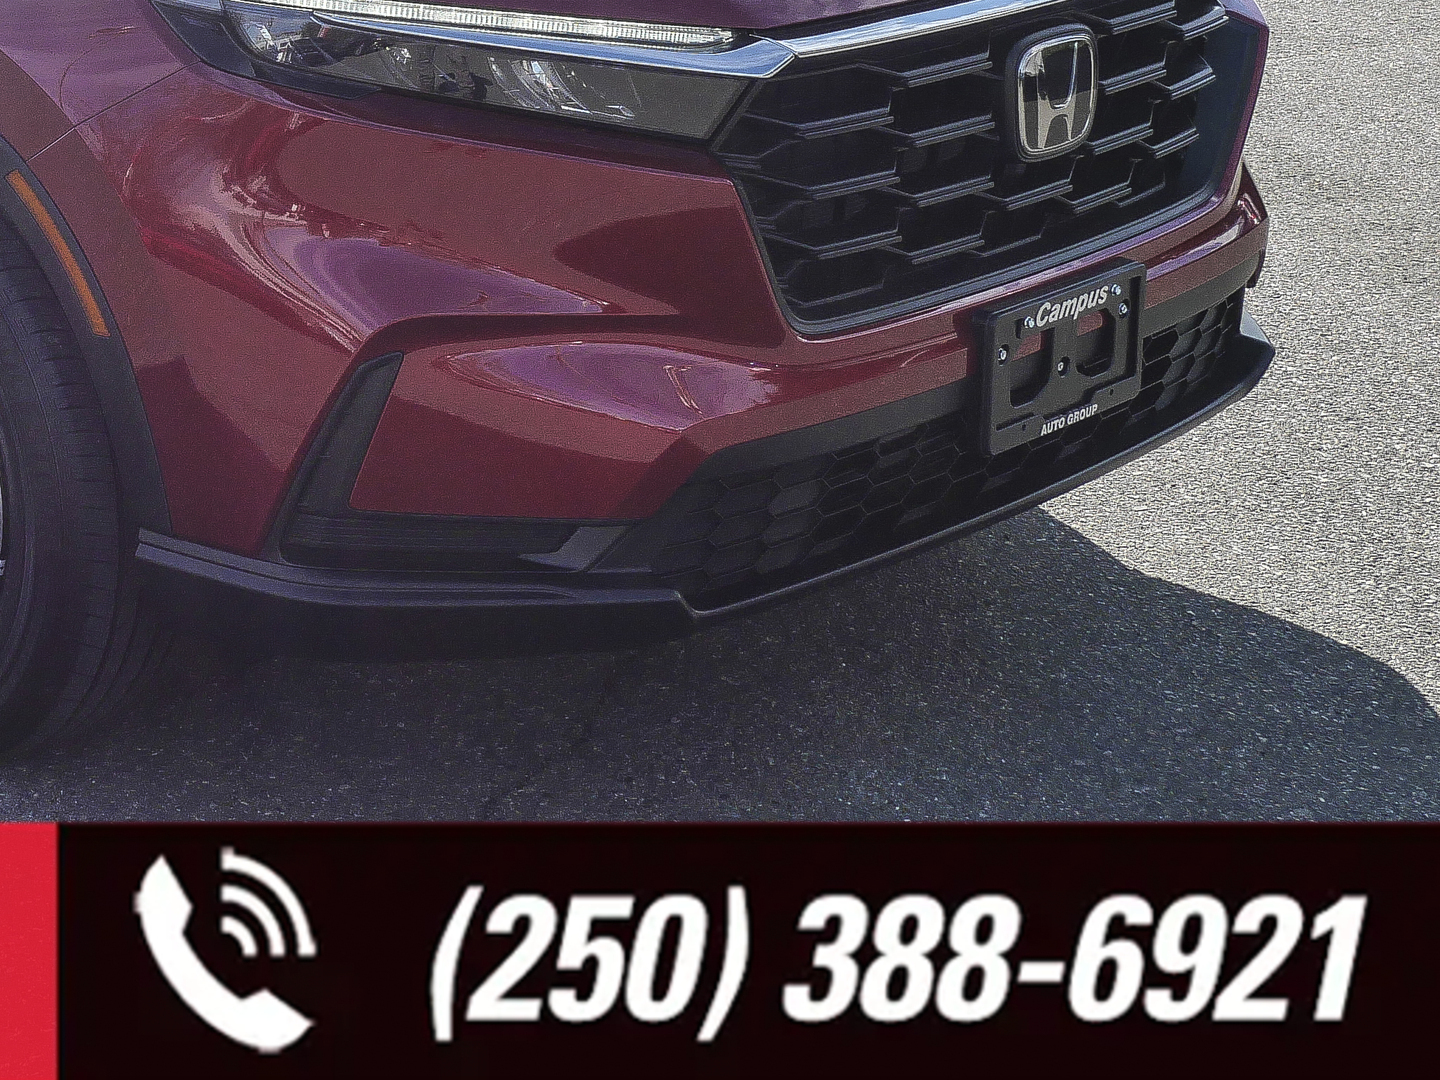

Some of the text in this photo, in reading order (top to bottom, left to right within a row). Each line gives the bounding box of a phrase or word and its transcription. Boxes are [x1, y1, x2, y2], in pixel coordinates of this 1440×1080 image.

[1035, 285, 1109, 328] Campus
[1040, 405, 1099, 437] AUTO GROUP
